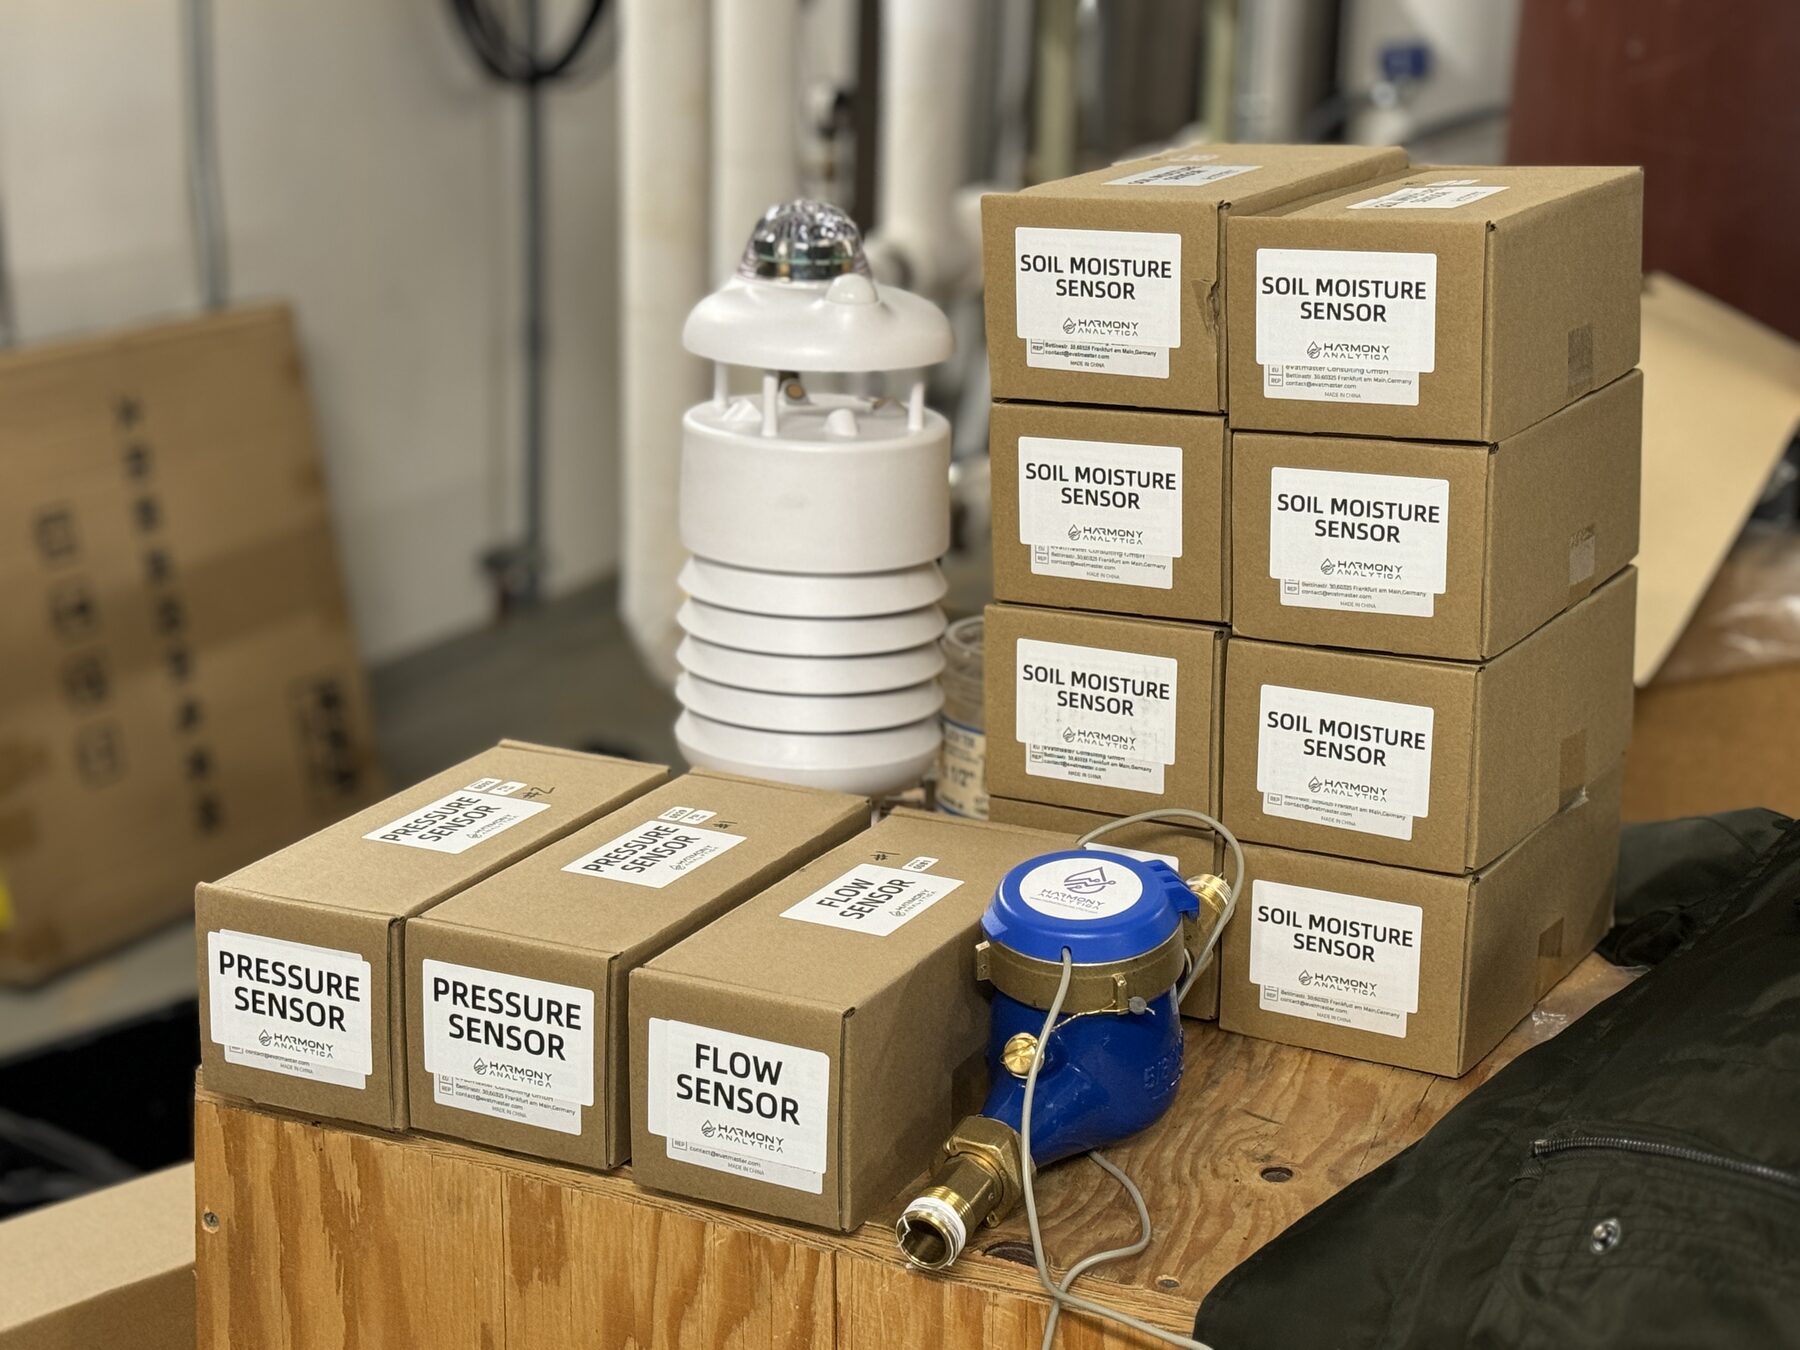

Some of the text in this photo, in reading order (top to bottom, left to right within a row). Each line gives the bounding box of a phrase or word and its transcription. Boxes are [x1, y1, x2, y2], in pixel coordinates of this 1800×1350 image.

[1021, 254, 1172, 278] SOIL MOISTURE
[1056, 279, 1135, 300] SENSOR
[1262, 277, 1427, 299] SOIL MOISTURE
[1300, 302, 1387, 322] SENSOR
[1078, 319, 1139, 330] HARMONY
[1078, 328, 1138, 336] ANALYTICA
[1323, 343, 1390, 353] HARMONY
[1323, 352, 1389, 360] ANALYTICA
[1026, 463, 1176, 490] SOIL MOISTURE
[1061, 488, 1140, 509] SENSOR
[1277, 494, 1440, 523] SOIL MOISTURE
[1083, 535, 1143, 545] ANALYTICA
[1084, 527, 1143, 538] HARMONY
[1315, 520, 1400, 543] SENSOR
[1337, 570, 1401, 580] ANALYTICA
[1338, 561, 1403, 573] HARMONY
[1023, 664, 1170, 700] SOIL MOISTURE
[1057, 691, 1134, 716] SENSOR
[1078, 730, 1136, 743] HARMONY
[1267, 711, 1426, 750] SOIL MOISTURE
[1077, 738, 1136, 750] ANALYTICA
[1304, 739, 1386, 766] SENSOR
[1324, 787, 1387, 802] ANALYTICA
[1325, 779, 1387, 795] HARMONY
[380, 796, 482, 841] PRESSURE
[418, 805, 502, 842] SENSOR
[581, 825, 679, 872] PRESSURE
[620, 835, 702, 873] SENSOR
[816, 878, 875, 908] FLOW
[839, 879, 916, 920] SENSOR
[1041, 889, 1105, 906] HARMONY
[1258, 905, 1413, 947] SOIL MOISTURE
[1293, 933, 1375, 962] SENSOR
[219, 951, 360, 1002] PRESSURE
[1315, 973, 1377, 990] HARMONY
[1314, 982, 1376, 997] ANALYTICA
[235, 986, 347, 1032] SENSOR
[434, 977, 581, 1030] PRESSURE
[274, 1033, 334, 1051] HARMONY
[449, 1014, 566, 1061] SENSOR
[273, 1042, 333, 1059] ANALYTICA
[490, 1061, 552, 1079] HARMONY
[695, 1043, 782, 1085] FLOW
[489, 1071, 552, 1088] ANALYTICA
[676, 1073, 800, 1126] SENSOR
[718, 1124, 784, 1145] HARMONY
[718, 1133, 783, 1153] ANALYTICA
